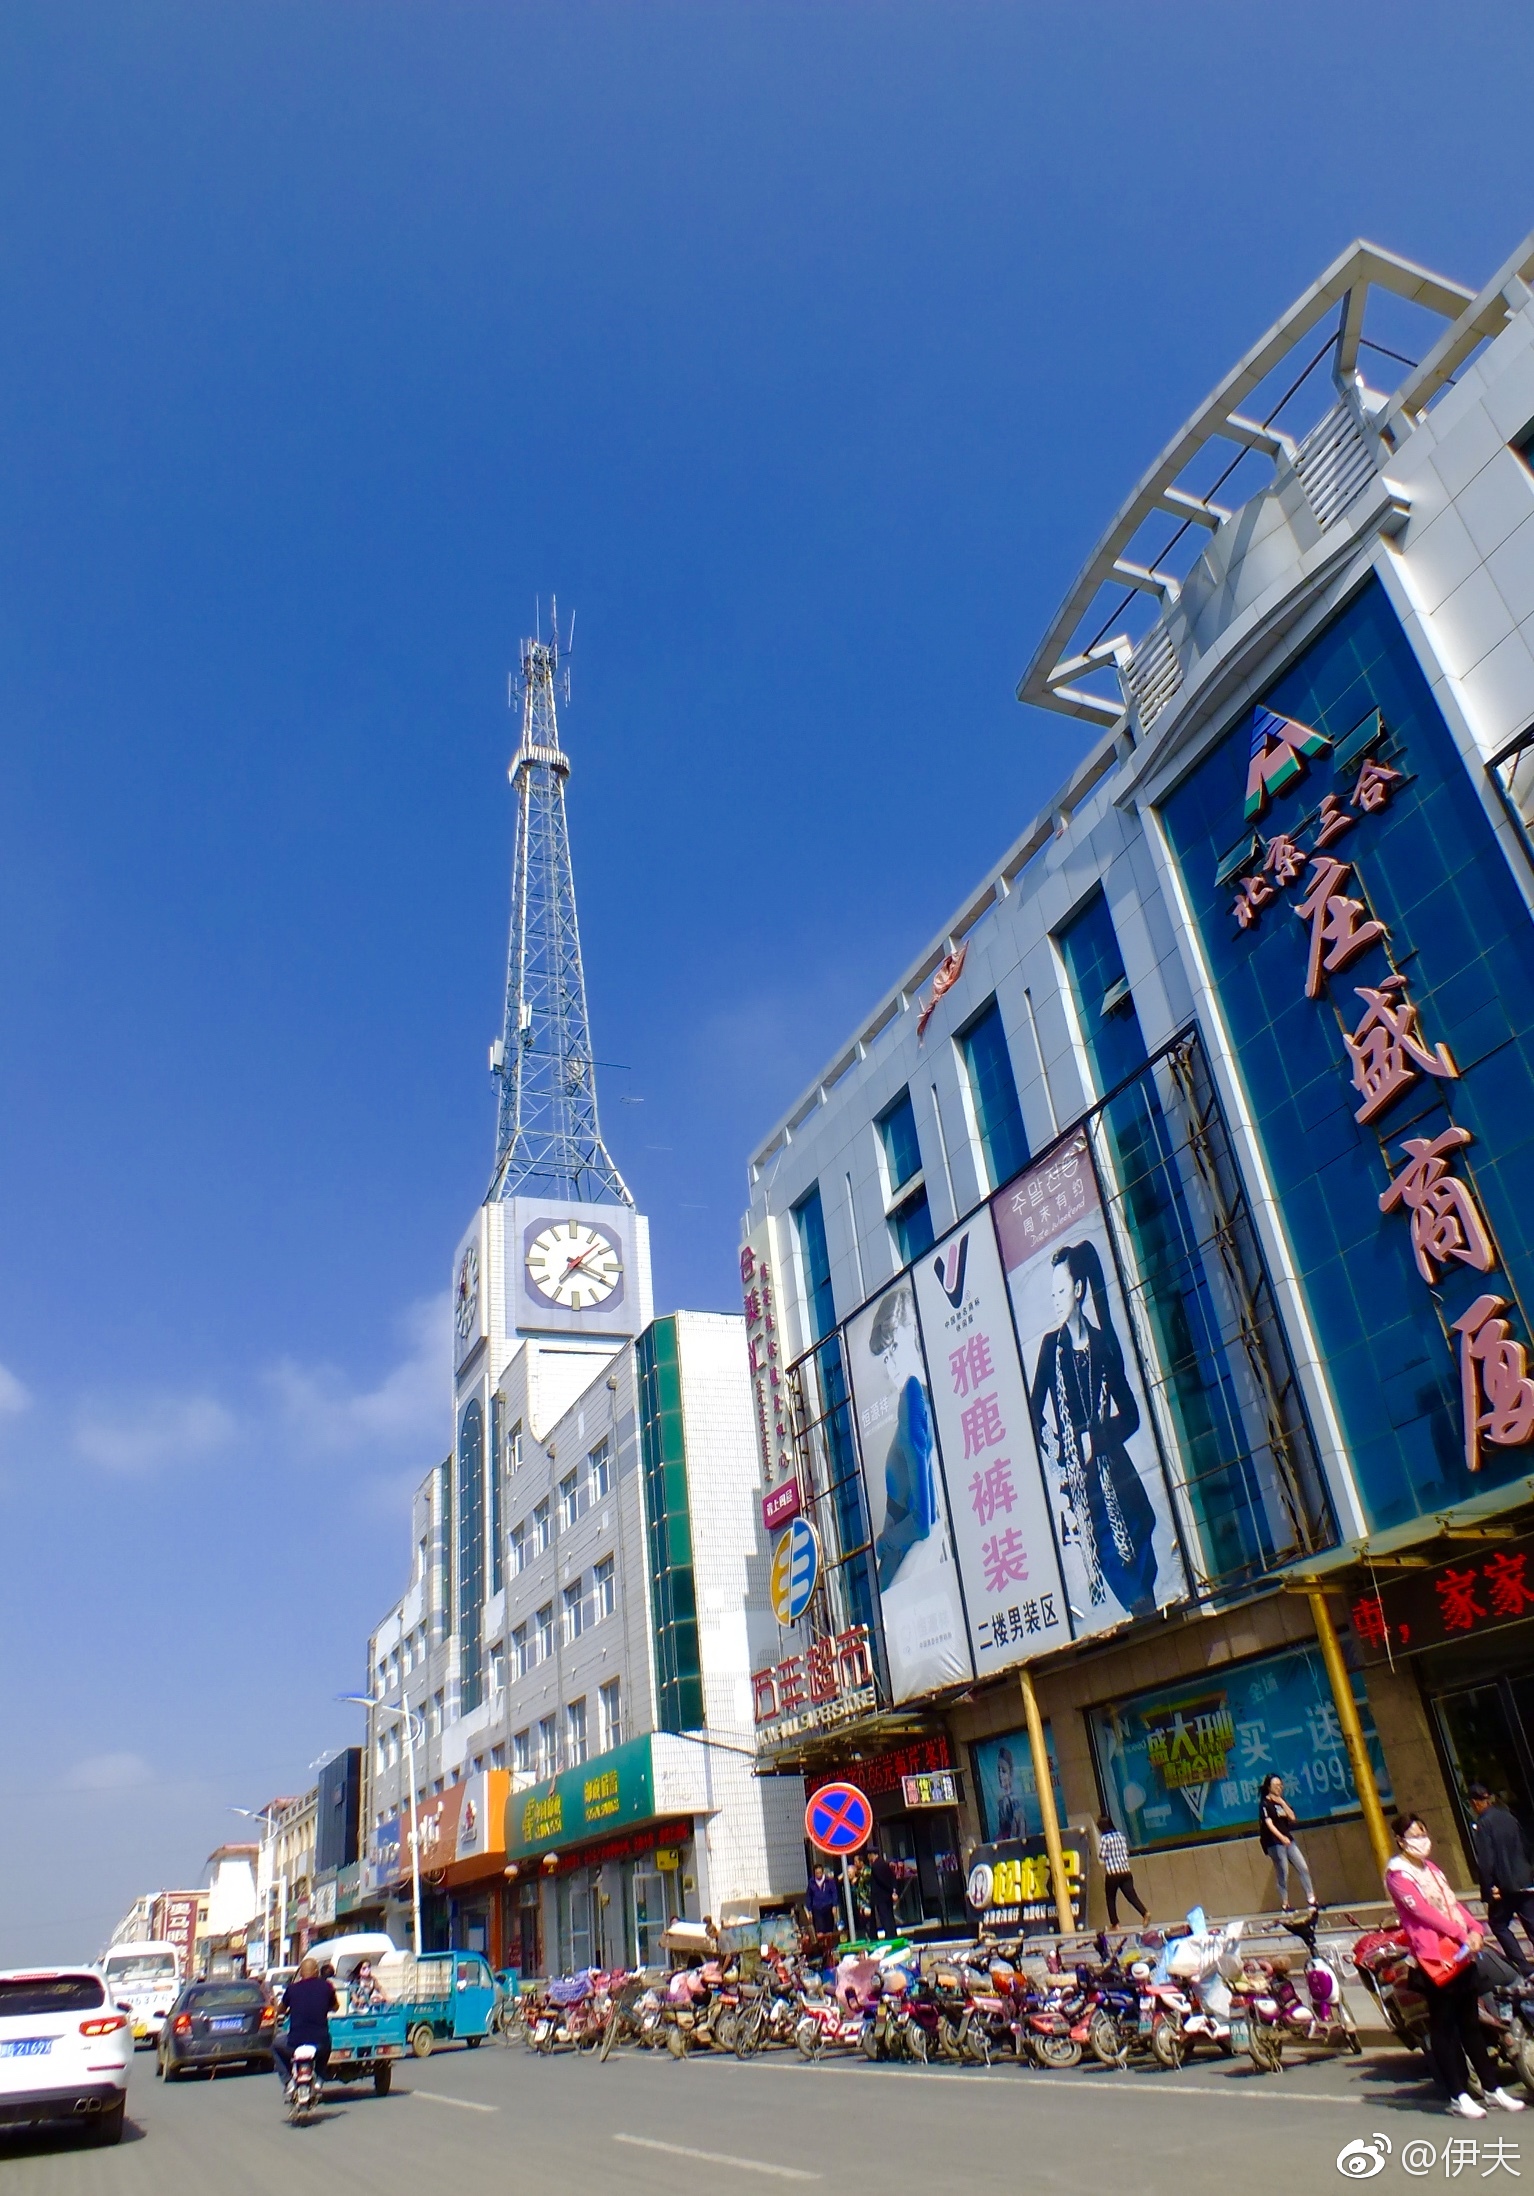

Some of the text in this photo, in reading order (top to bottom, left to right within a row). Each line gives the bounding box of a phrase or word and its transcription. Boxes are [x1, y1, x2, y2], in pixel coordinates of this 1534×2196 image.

[1233, 758, 1402, 928] 北京三合
[861, 1394, 890, 1428] 恒源祥
[949, 1331, 1029, 1593] 雅鹿裤装
[978, 1592, 1059, 1651] 二楼男装区
[800, 1686, 876, 1730] SUPERSTORE
[1147, 1711, 1235, 1766] 盛大开业
